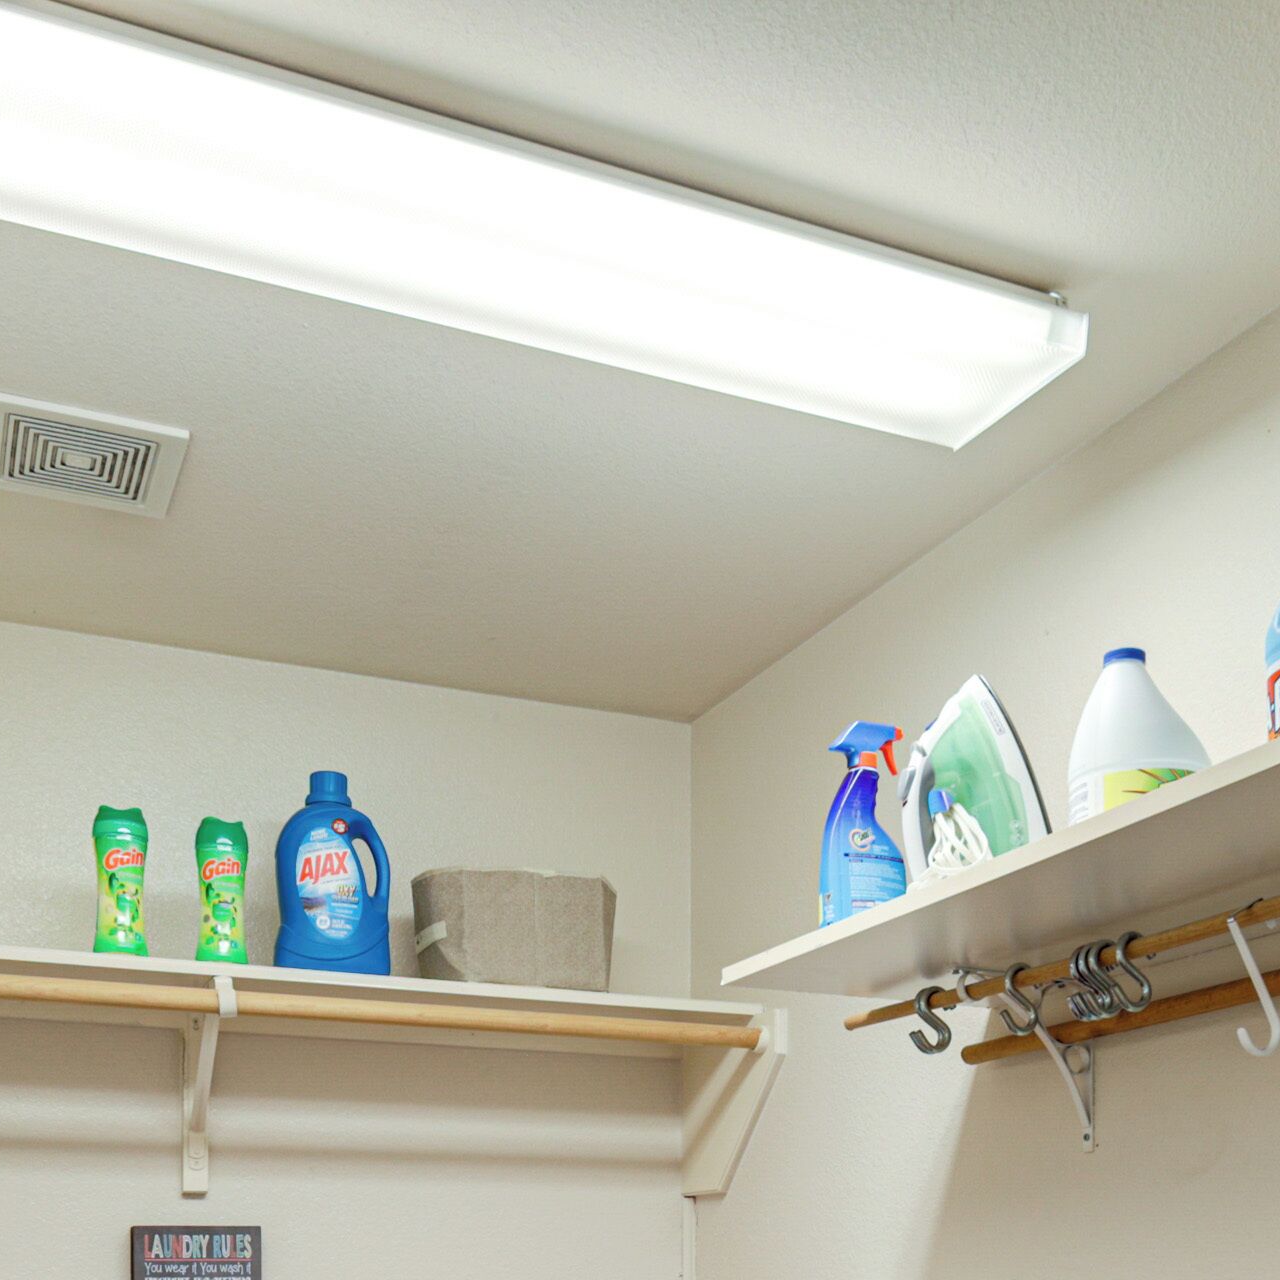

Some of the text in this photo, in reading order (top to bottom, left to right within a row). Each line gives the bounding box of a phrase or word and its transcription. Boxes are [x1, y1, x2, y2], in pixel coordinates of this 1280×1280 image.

[104, 848, 144, 871] Gain
[202, 858, 241, 881] Gain
[299, 850, 349, 885] AJAX
[144, 1234, 252, 1259] LAUNDRY RULES
[144, 1262, 163, 1275] You
[164, 1264, 189, 1275] wear
[200, 1262, 218, 1275] You
